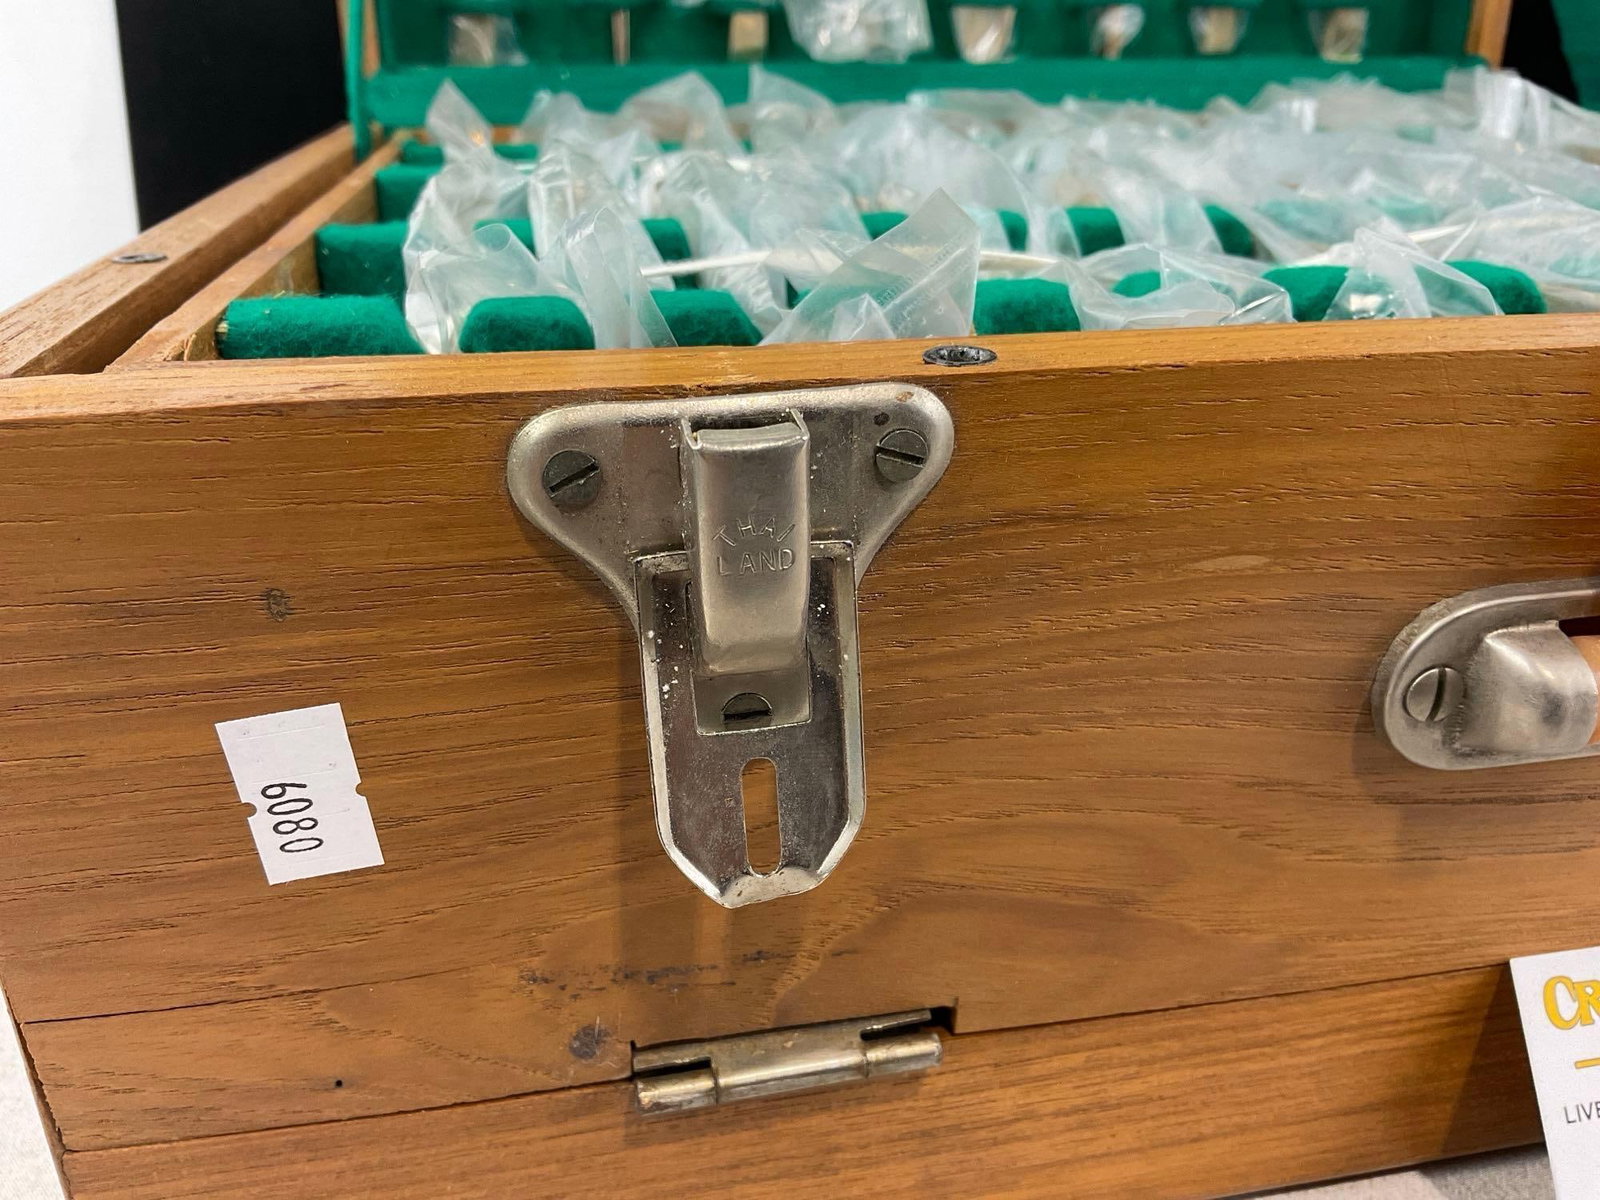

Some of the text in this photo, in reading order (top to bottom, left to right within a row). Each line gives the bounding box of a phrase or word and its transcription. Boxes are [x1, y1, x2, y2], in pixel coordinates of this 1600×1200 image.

[712, 514, 796, 547] THAI
[716, 548, 794, 576] LAND
[260, 782, 324, 853] 6080
